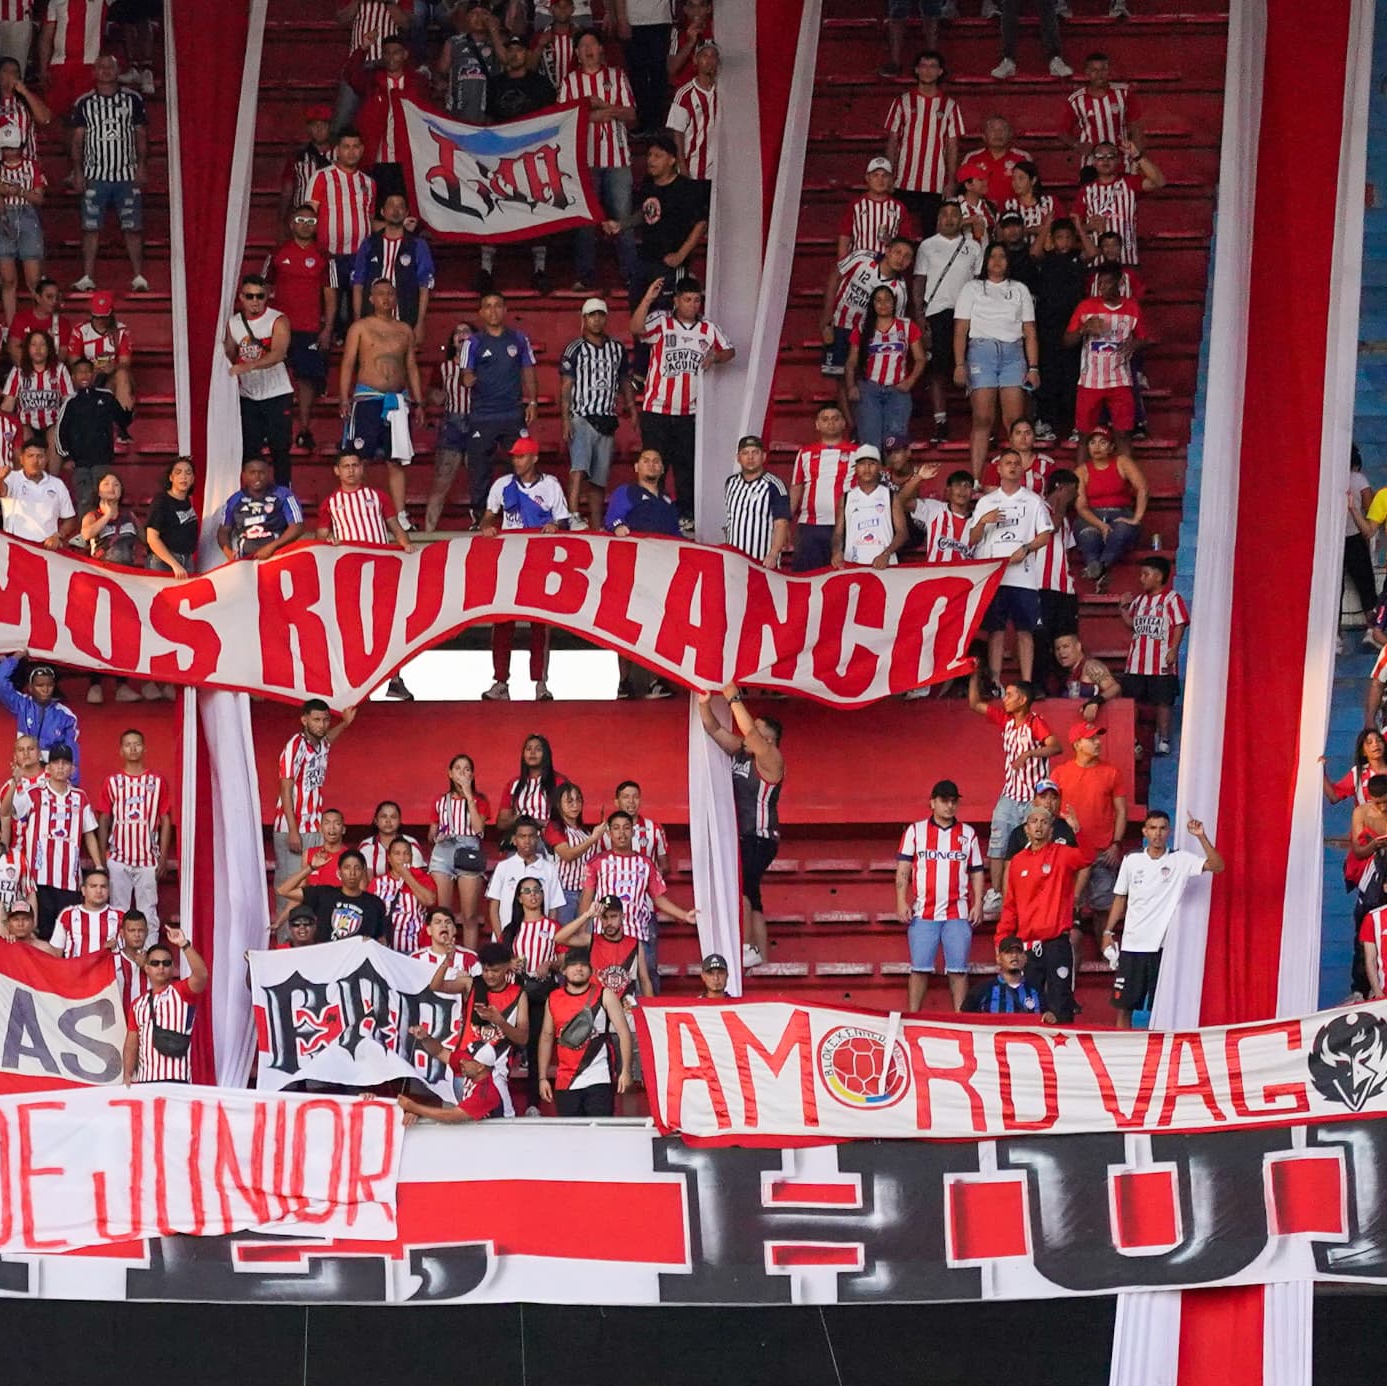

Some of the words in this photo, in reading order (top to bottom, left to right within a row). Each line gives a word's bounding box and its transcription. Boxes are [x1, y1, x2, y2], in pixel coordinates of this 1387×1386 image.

[664, 334, 677, 348] 10
[261, 536, 973, 698] ROJIBLANCO
[92, 1096, 397, 1243] JUNIOR
